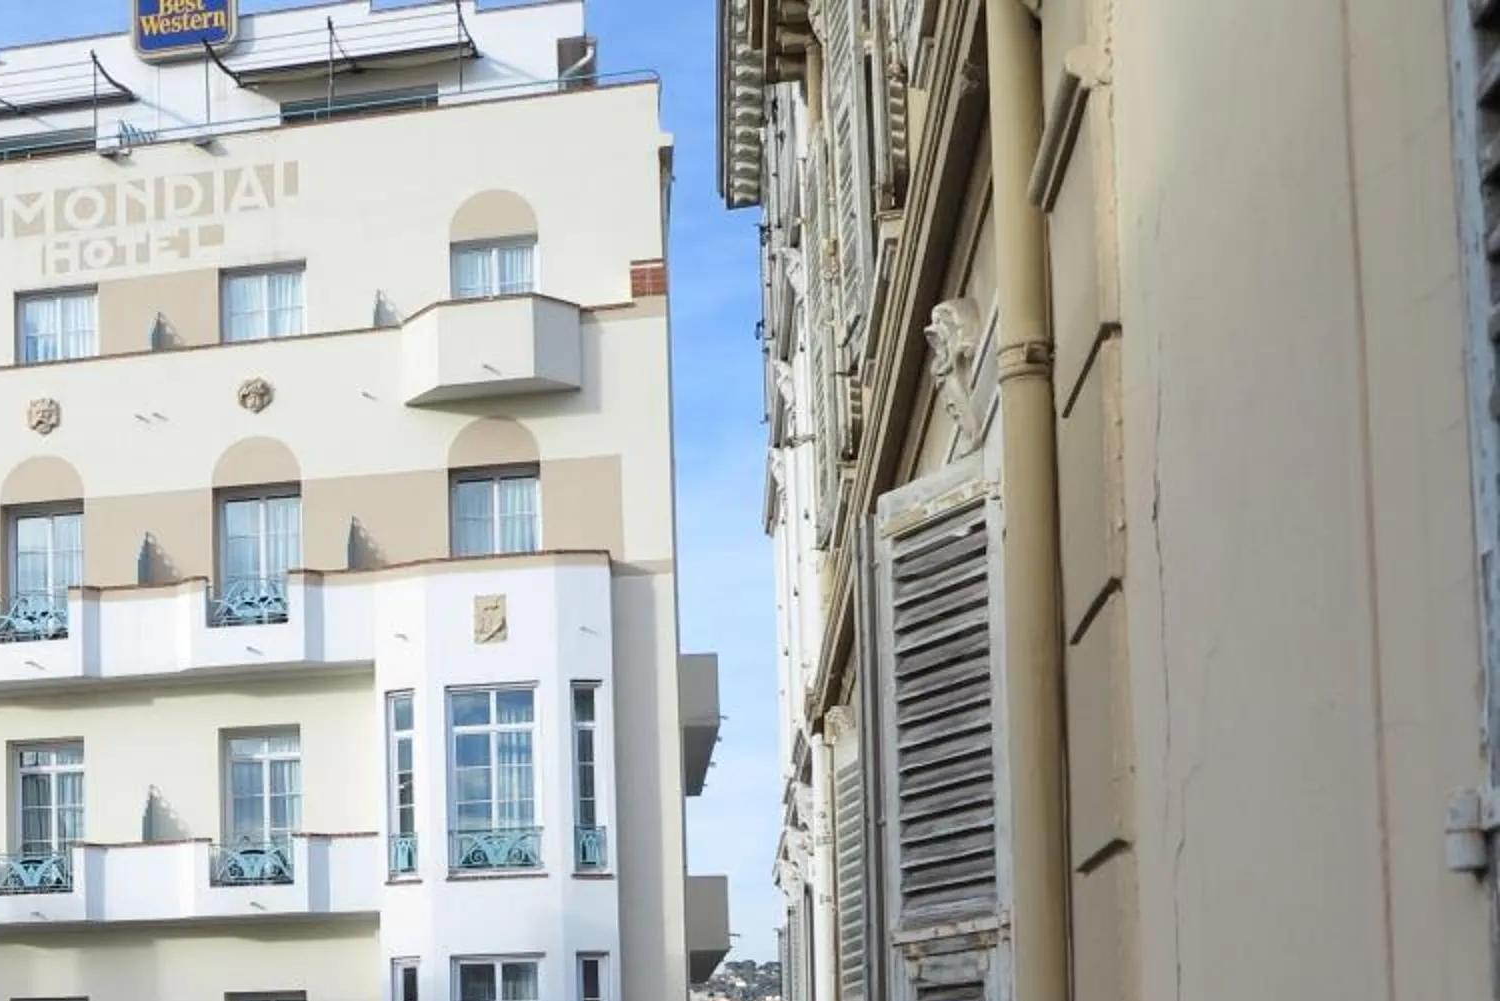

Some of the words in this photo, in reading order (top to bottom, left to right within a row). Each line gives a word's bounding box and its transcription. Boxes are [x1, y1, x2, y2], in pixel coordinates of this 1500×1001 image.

[140, 11, 226, 36] Western
[160, 0, 206, 15] Best
[0, 160, 300, 240] MONDIAL
[41, 222, 226, 277] HOTEL
